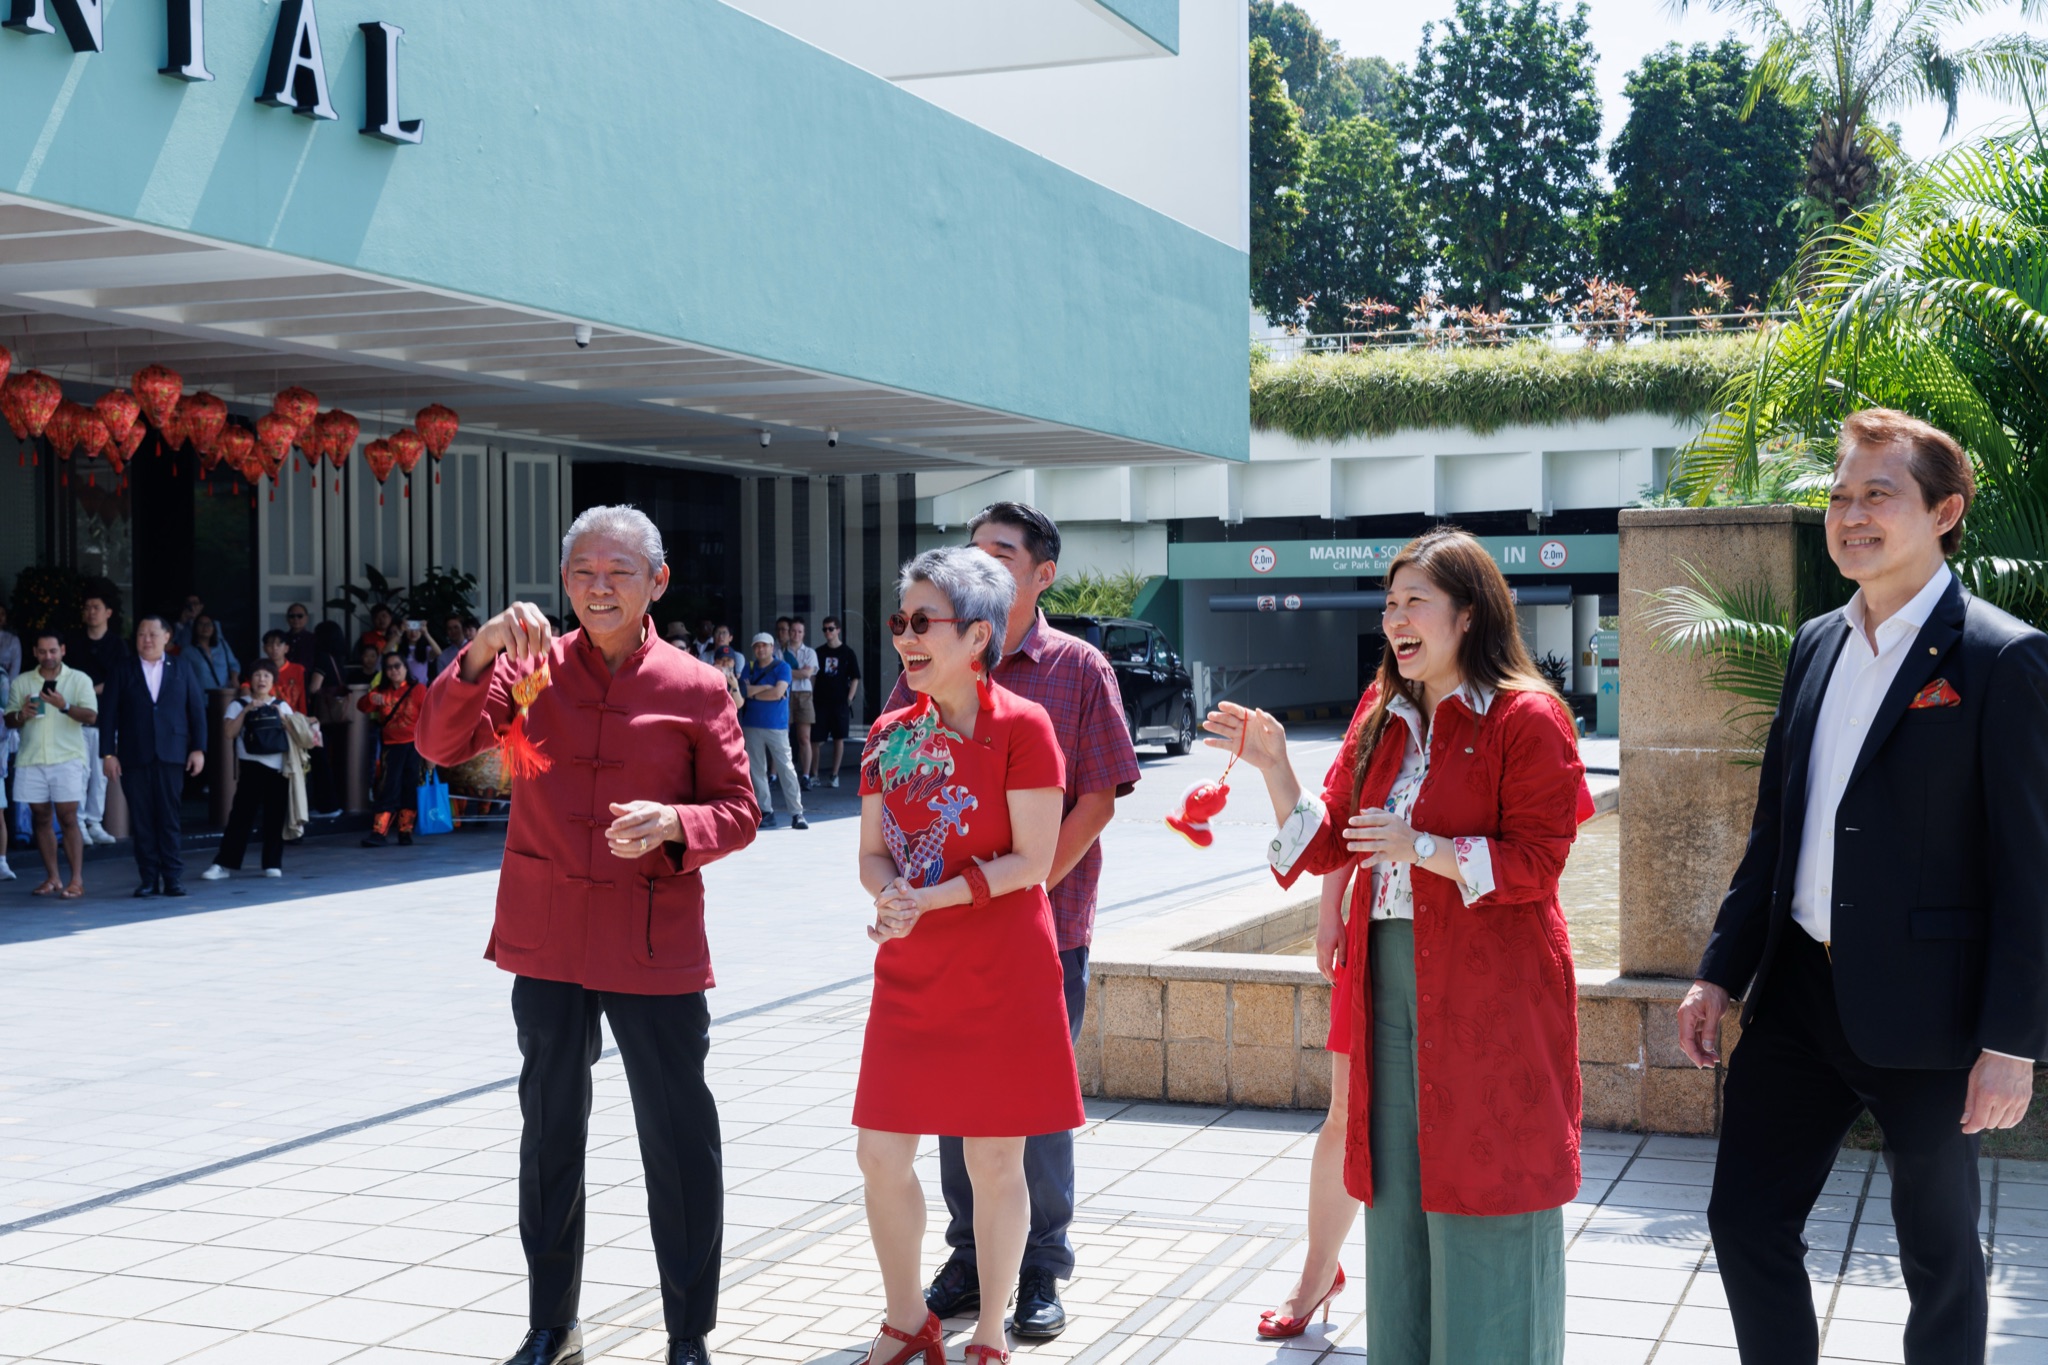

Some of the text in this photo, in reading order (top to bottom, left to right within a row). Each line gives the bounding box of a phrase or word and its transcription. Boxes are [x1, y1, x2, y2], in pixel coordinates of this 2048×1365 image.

[1310, 546, 1373, 559] MARINA
[1504, 546, 1526, 564] IN
[1543, 550, 1564, 560] 2.0m
[1254, 554, 1273, 564] 2.0m
[1333, 561, 1347, 570] Car
[1351, 560, 1370, 569] Park
